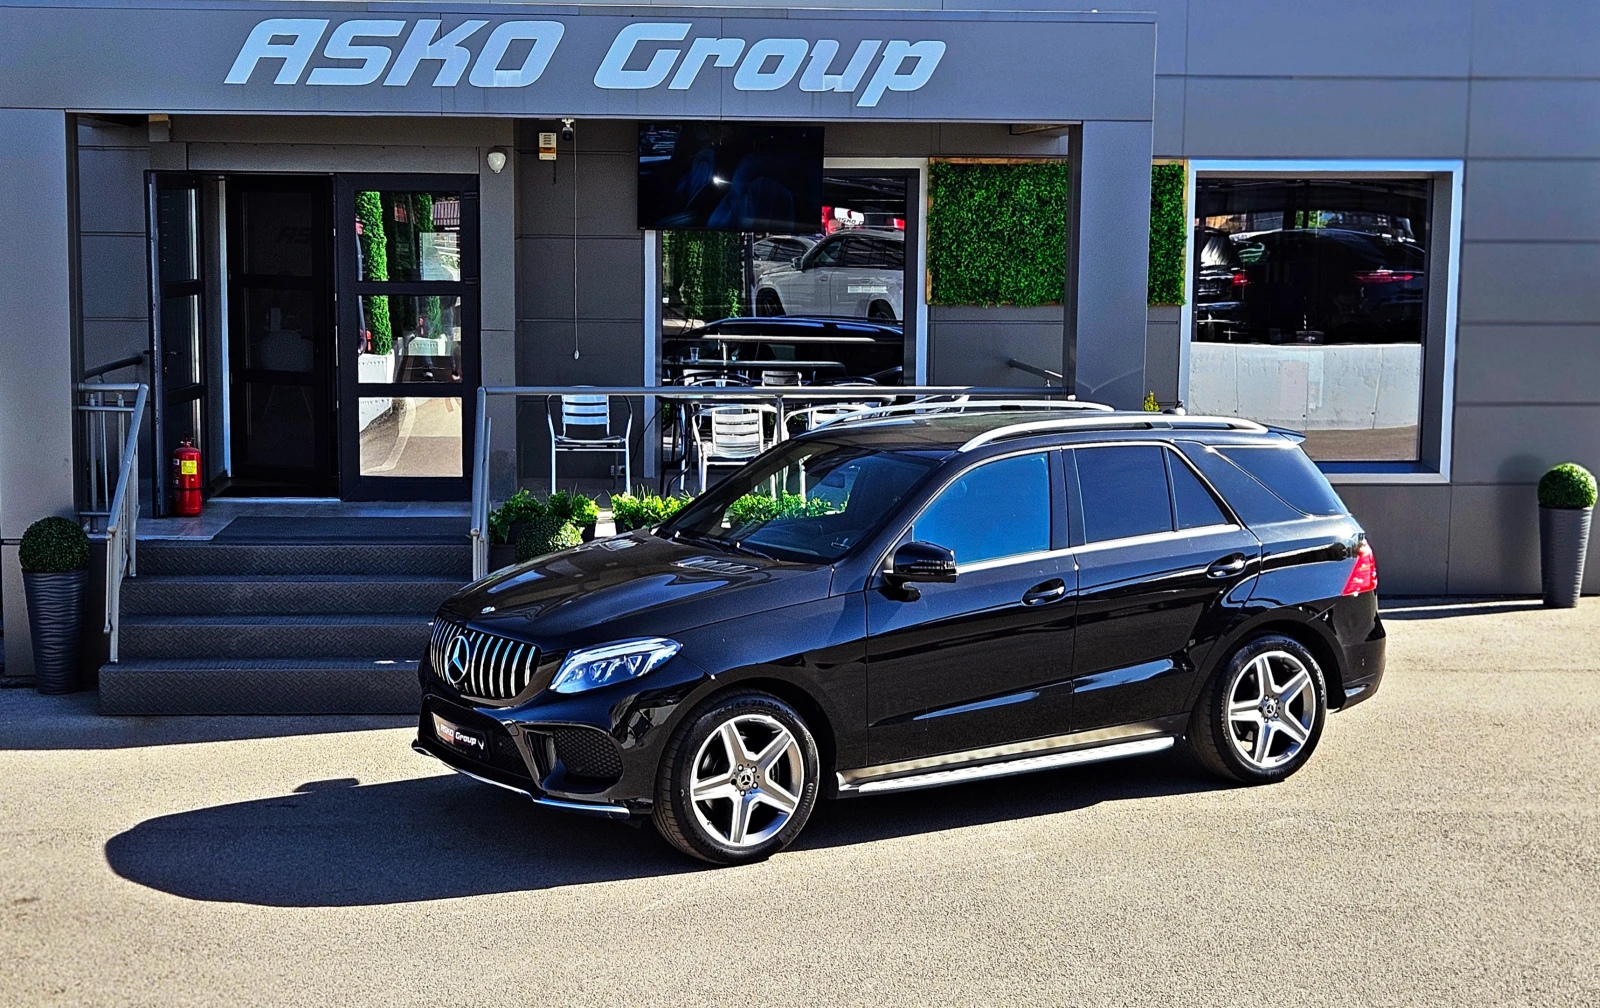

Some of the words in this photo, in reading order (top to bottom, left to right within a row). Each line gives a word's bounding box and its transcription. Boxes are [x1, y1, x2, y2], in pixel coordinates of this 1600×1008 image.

[224, 19, 565, 87] ASKO
[593, 23, 946, 107] Group
[455, 731, 477, 746] Group
